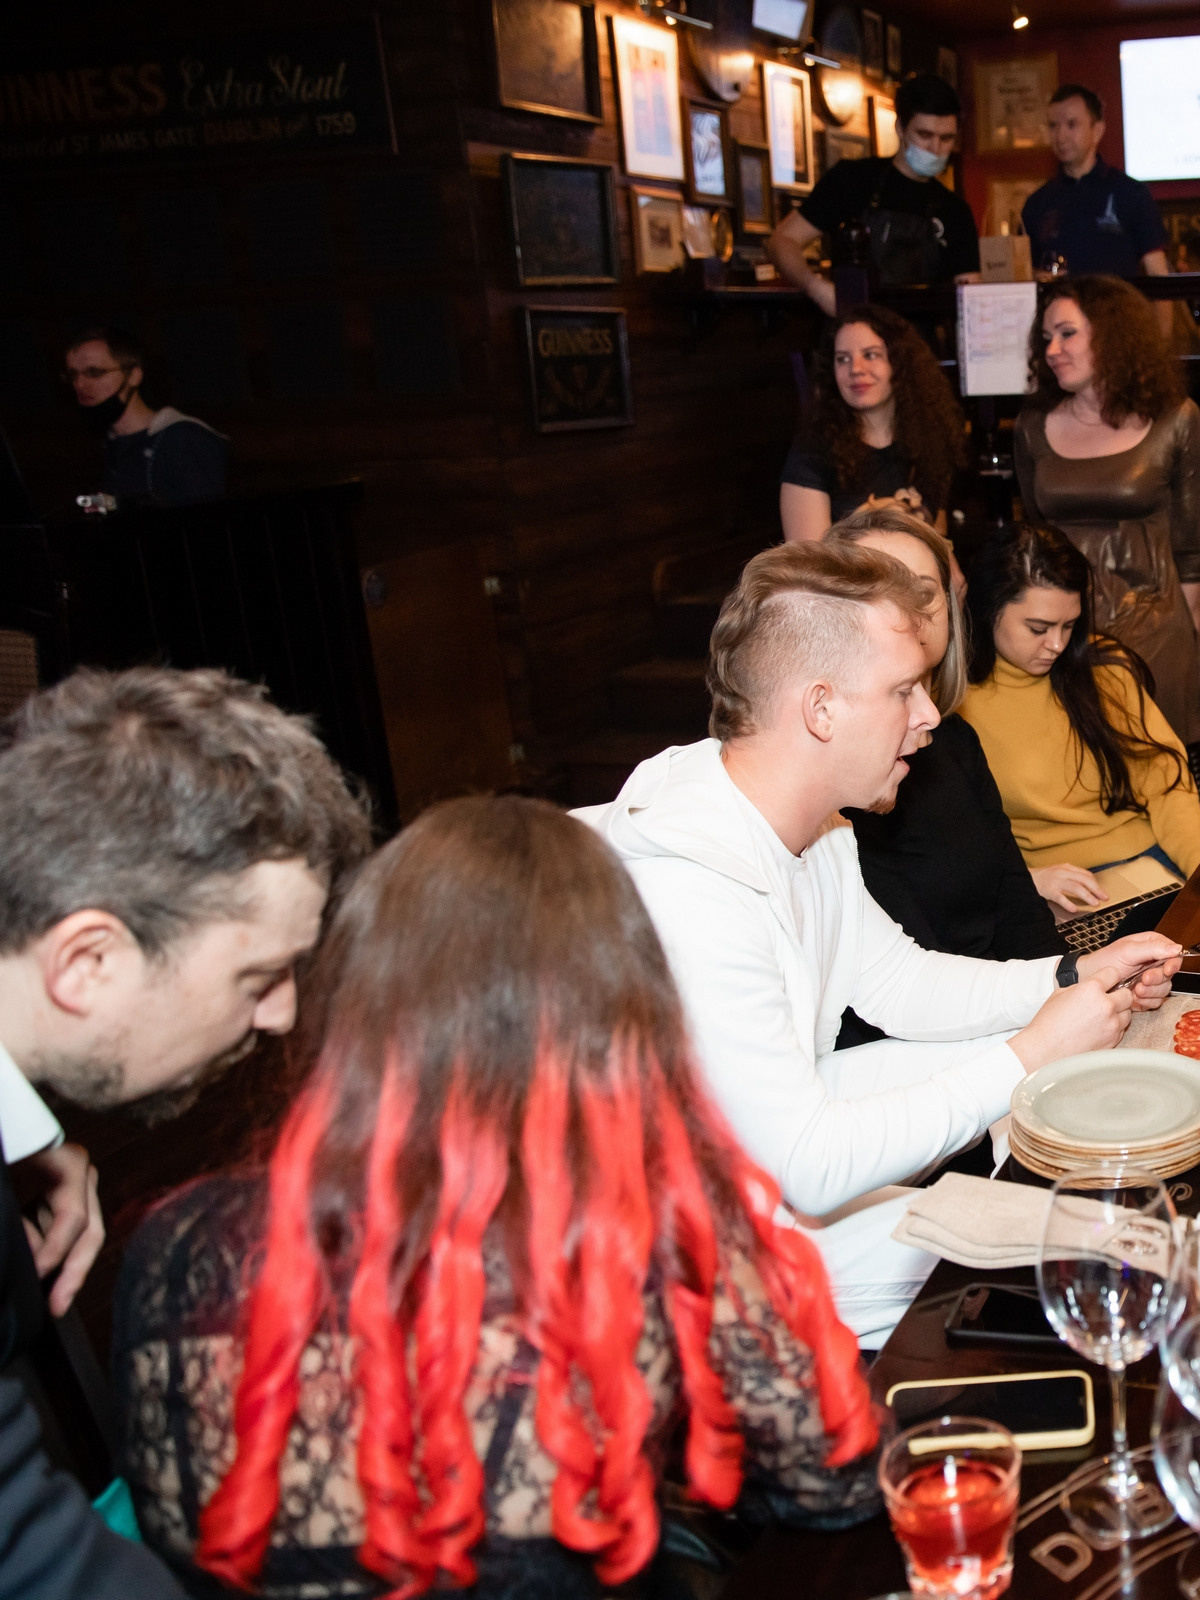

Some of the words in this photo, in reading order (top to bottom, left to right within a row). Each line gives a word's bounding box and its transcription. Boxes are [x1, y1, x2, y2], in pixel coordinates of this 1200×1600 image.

[178, 54, 266, 118] Extra
[266, 52, 350, 104] Stout
[315, 111, 358, 136] 1759
[537, 327, 614, 358] GUINNESS
